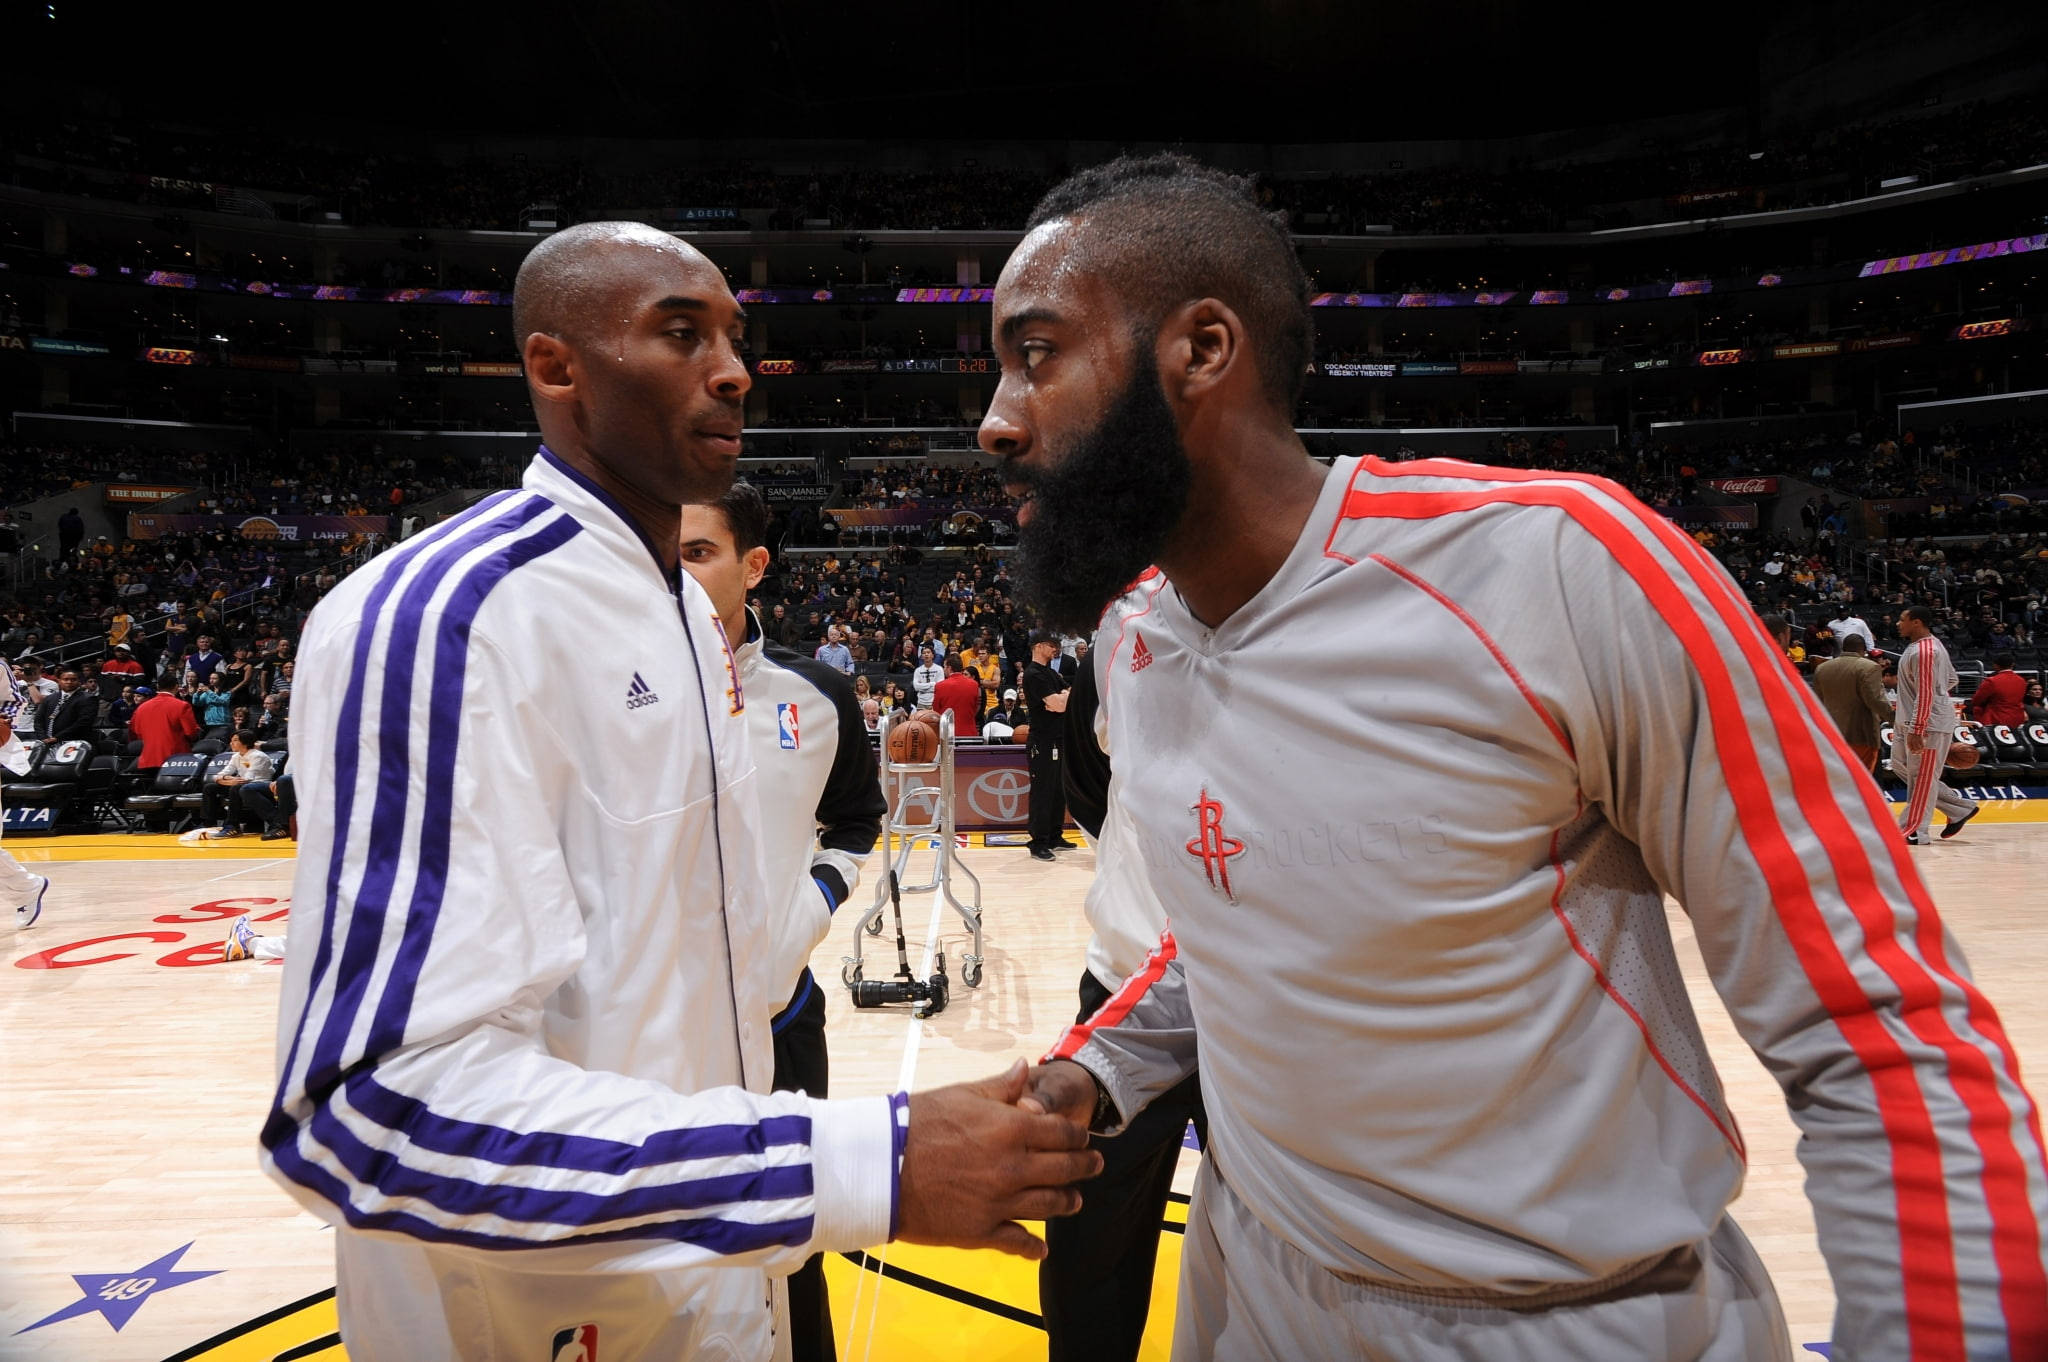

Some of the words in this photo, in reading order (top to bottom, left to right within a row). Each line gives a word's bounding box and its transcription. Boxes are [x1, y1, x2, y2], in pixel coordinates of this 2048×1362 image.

[698, 209, 735, 217] DELTA
[896, 361, 937, 370] DELTA
[767, 487, 785, 496] SAN
[792, 487, 828, 496] MANUEL
[1721, 478, 1768, 493] Coca-Cola
[1131, 653, 1153, 672] adidas
[627, 693, 659, 709] adidas
